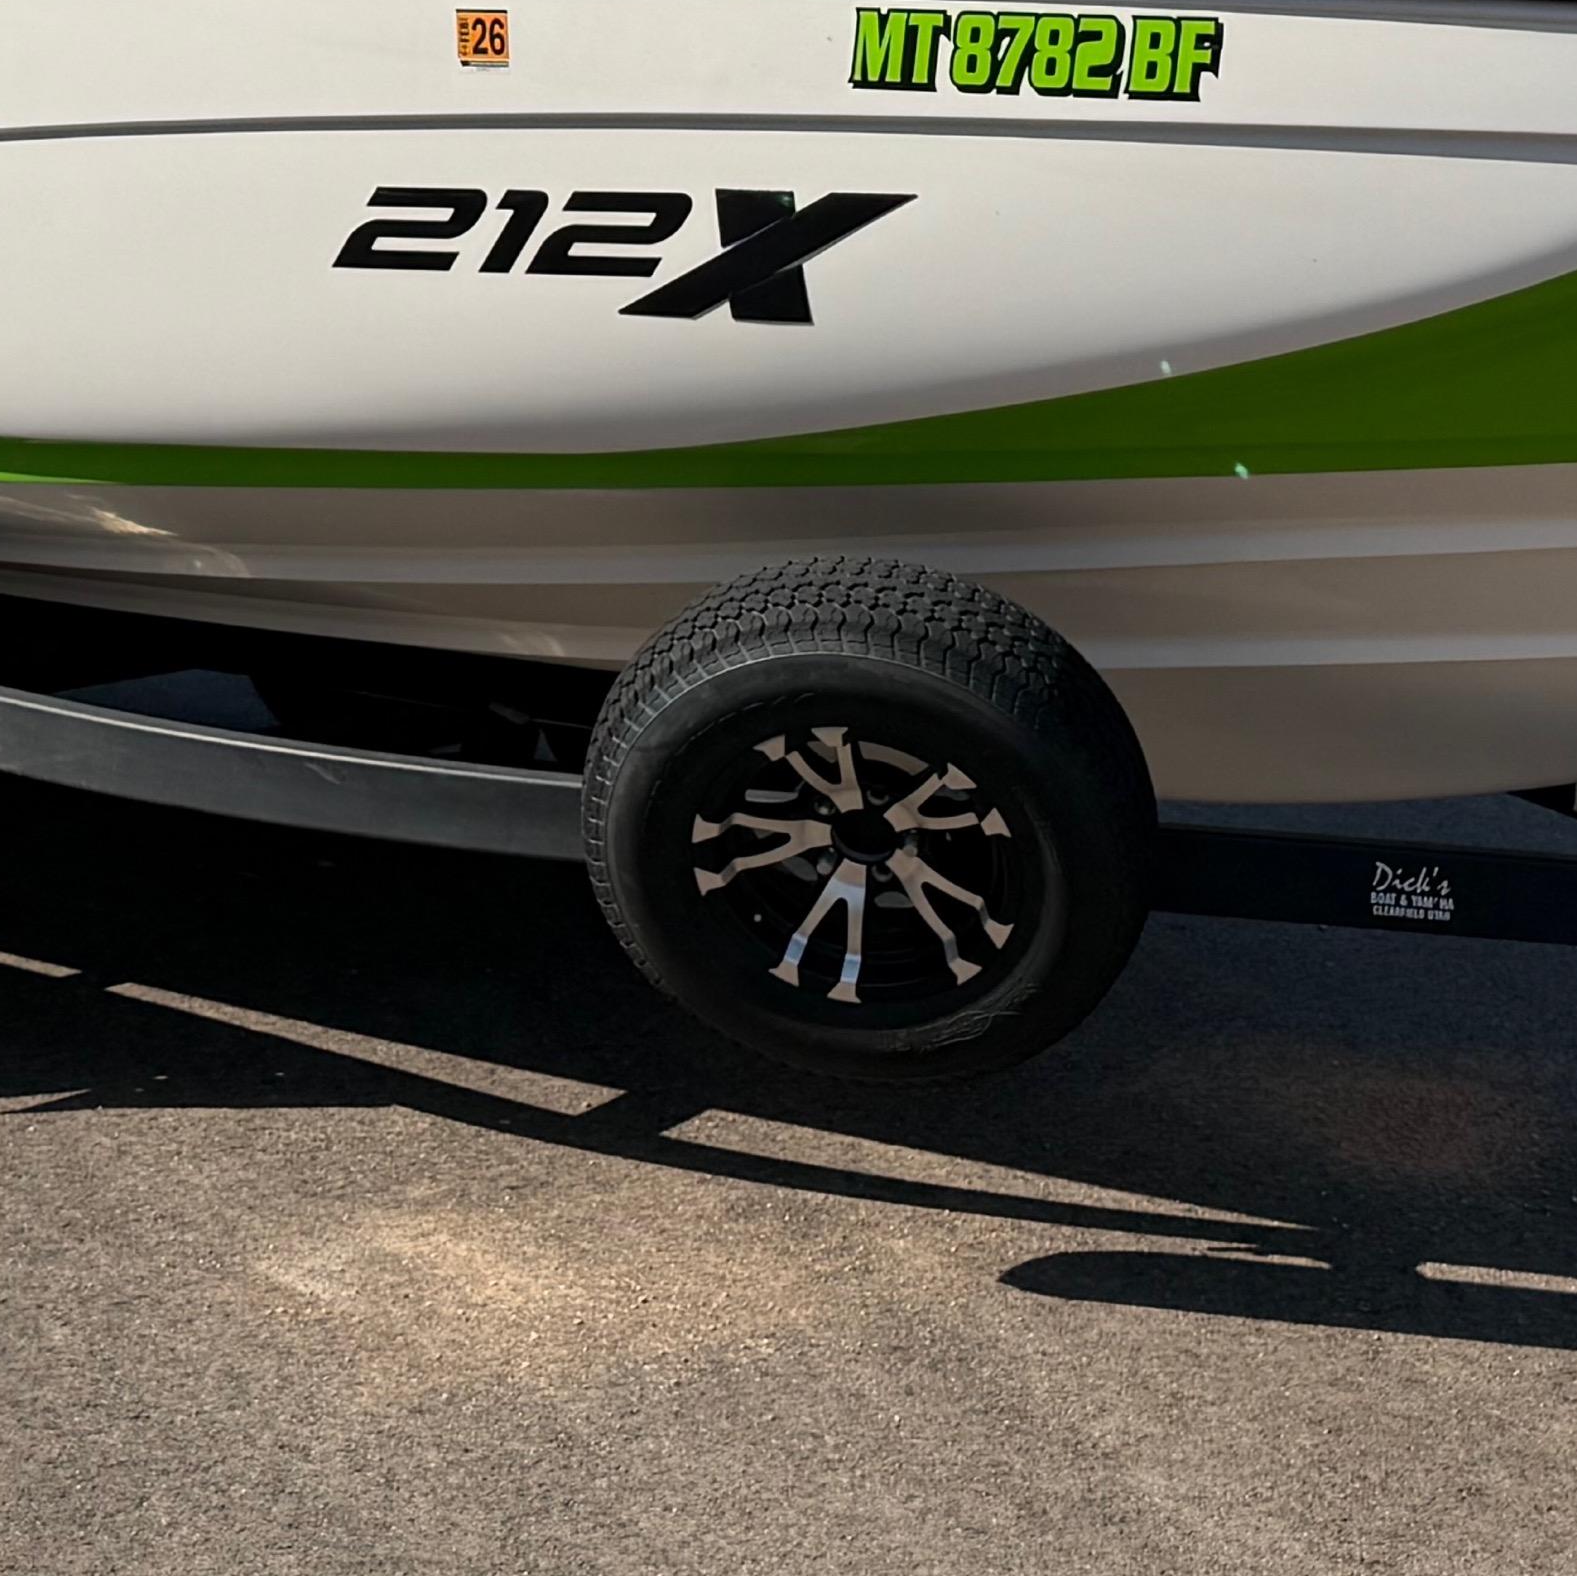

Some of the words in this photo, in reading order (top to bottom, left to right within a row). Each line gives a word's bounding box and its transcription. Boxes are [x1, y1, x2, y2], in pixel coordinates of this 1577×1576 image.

[471, 17, 505, 55] 26
[848, 8, 951, 92] MT
[950, 11, 1125, 99] 8782
[1124, 15, 1223, 102] BF
[333, 187, 918, 326] 212X
[1372, 861, 1452, 896] Dick's
[1370, 891, 1397, 905] BOAT
[1399, 894, 1408, 906] &
